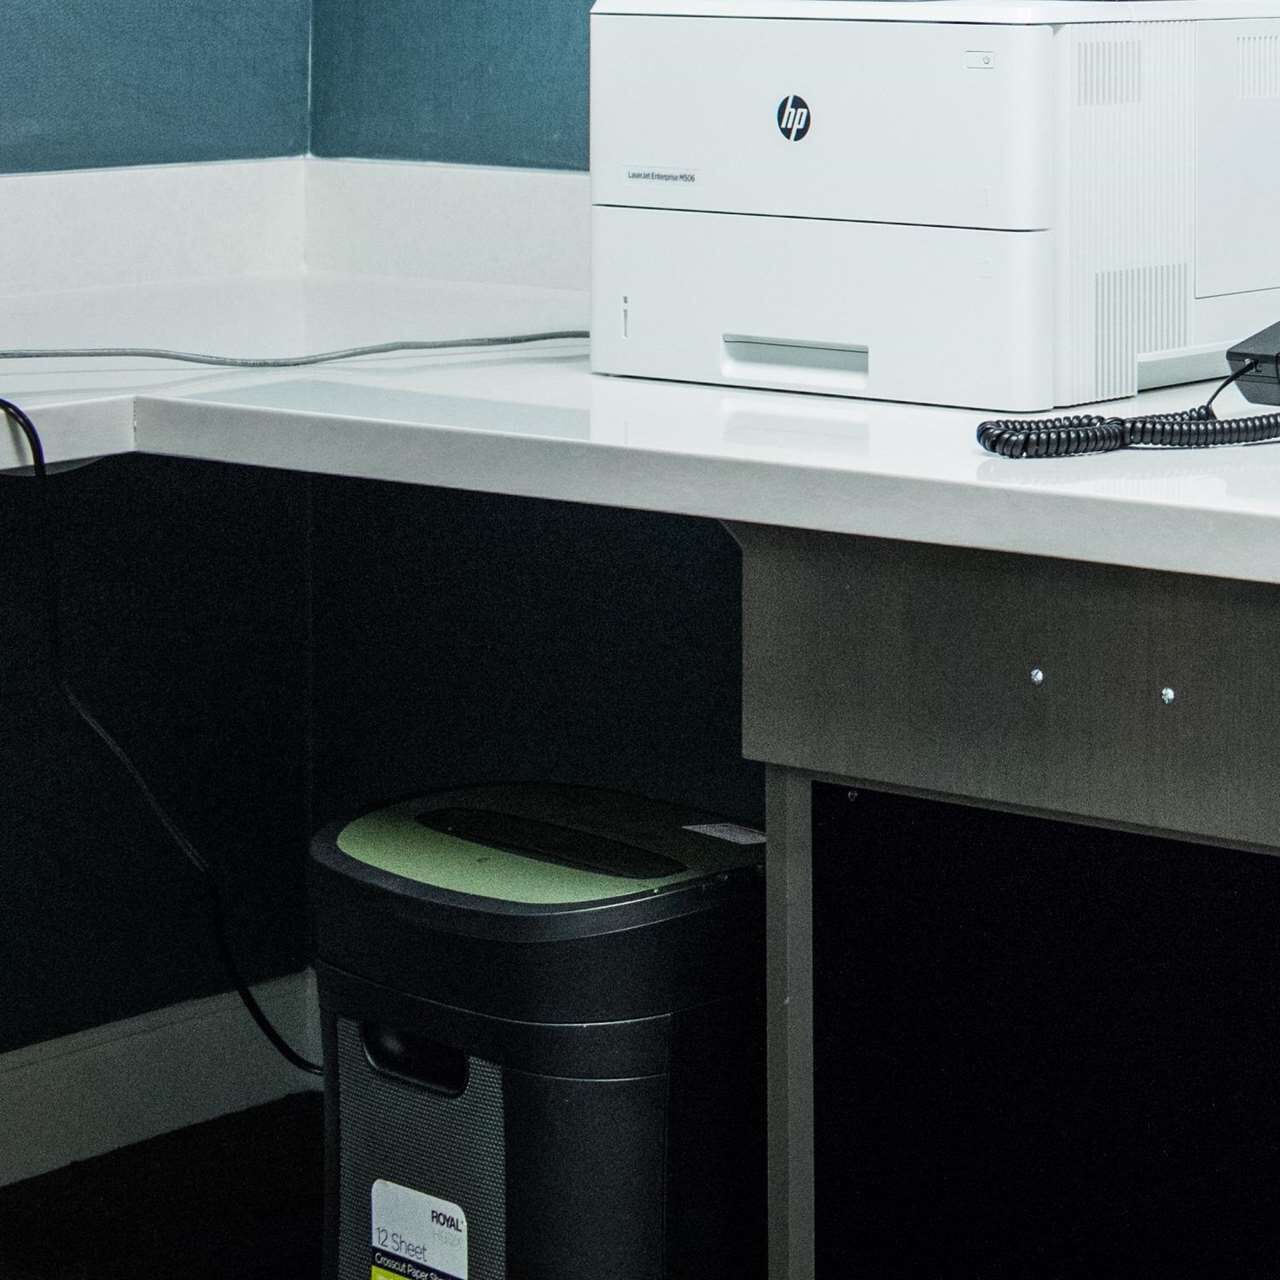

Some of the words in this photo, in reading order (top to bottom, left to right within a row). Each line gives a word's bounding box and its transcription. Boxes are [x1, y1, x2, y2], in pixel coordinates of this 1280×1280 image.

[779, 94, 809, 141] hp
[431, 1210, 462, 1232] ROYAL
[376, 1226, 389, 1248] 12
[391, 1233, 427, 1262] Sheet
